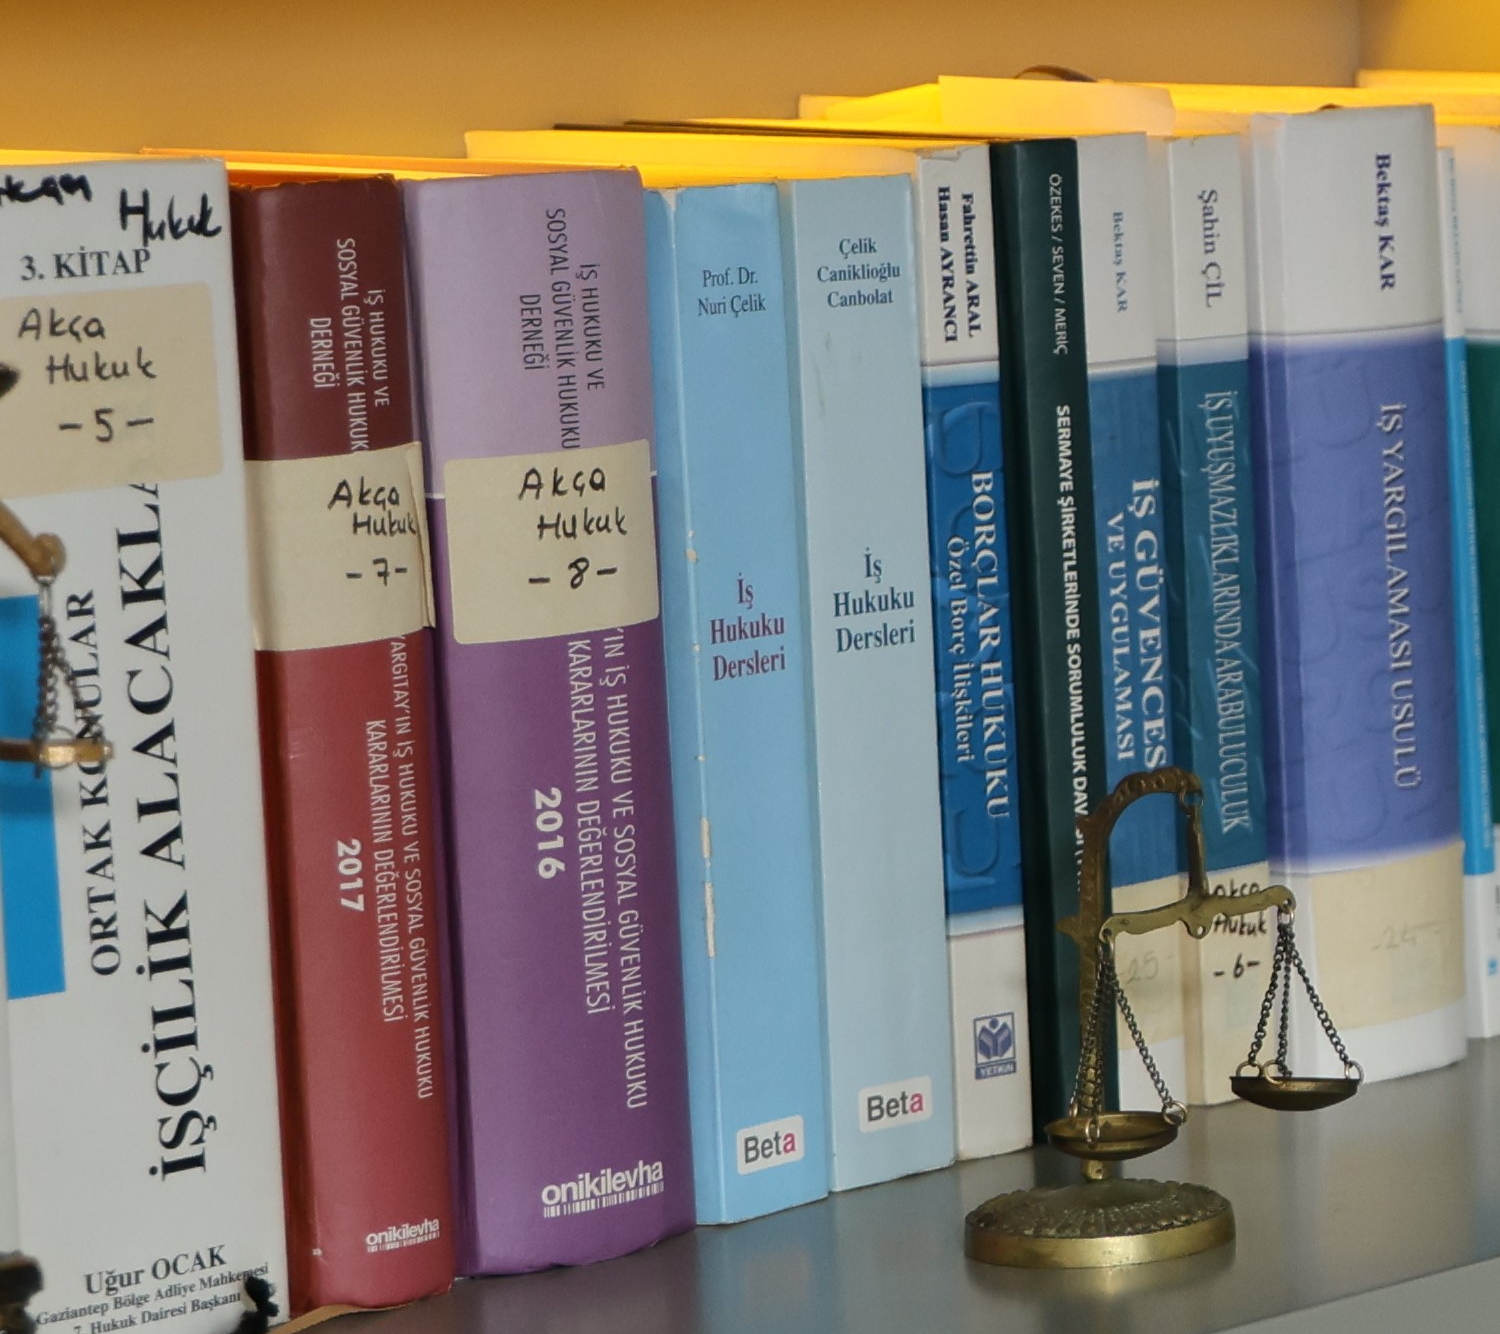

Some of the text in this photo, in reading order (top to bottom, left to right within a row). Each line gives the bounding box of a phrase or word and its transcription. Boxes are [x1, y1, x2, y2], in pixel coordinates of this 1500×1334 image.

[1197, 187, 1219, 255] Şahin
[1374, 153, 1396, 291] Bektaş KAR
[20, 246, 152, 281] 3. KİTAP
[838, 238, 878, 259] Çelik
[937, 186, 958, 343] Hasan AYRANCI
[702, 266, 759, 288] Prof. Dr.
[817, 262, 900, 285] Caniklioğlu
[697, 293, 766, 318] Nuri Çelik
[827, 290, 894, 308] Canbolat
[966, 279, 982, 339] ARAL
[519, 294, 550, 371] DERNEĞİ
[546, 208, 581, 450] SOSYAL GÜVENLİK HUKUKU
[581, 288, 605, 391] HUKUKU VE
[46, 346, 157, 384] Hukuk
[1056, 404, 1075, 492] SERMAYE
[538, 507, 627, 539] Hukuk
[864, 547, 882, 579] İş
[736, 572, 754, 610] İş
[833, 586, 915, 618] Hukuku
[946, 535, 969, 657] Özel Borç
[1375, 402, 1424, 790] İŞ YARGILAMASI USULÜ
[709, 613, 786, 645] Hukuku
[836, 619, 916, 654] Dersleri
[970, 470, 1011, 820] BORÇLAR HUKUKU
[1106, 512, 1136, 761] VE UYGULAMASI
[712, 647, 786, 682] Dersleri
[535, 787, 567, 879] 2016
[567, 639, 616, 1015] KARARLARININ DEĞERLENDİRİLMESİ
[83, 818, 121, 976] ORTAK
[337, 838, 365, 912] 2017
[606, 694, 649, 1109] HUKUKU VE SOSYAL GÜVENLİK HUKUKU
[136, 888, 217, 1182] İŞÇİLİK
[868, 1090, 924, 1122] Beta
[744, 1130, 797, 1164] Beta
[541, 1160, 664, 1208] onikilevha
[366, 1218, 440, 1247] onikilevha
[84, 1244, 228, 1298] Uğur OCAK
[113, 1281, 198, 1312] Bölge Adliye
[140, 1305, 189, 1326] Dairesi
[190, 1292, 242, 1316] Başkanı
